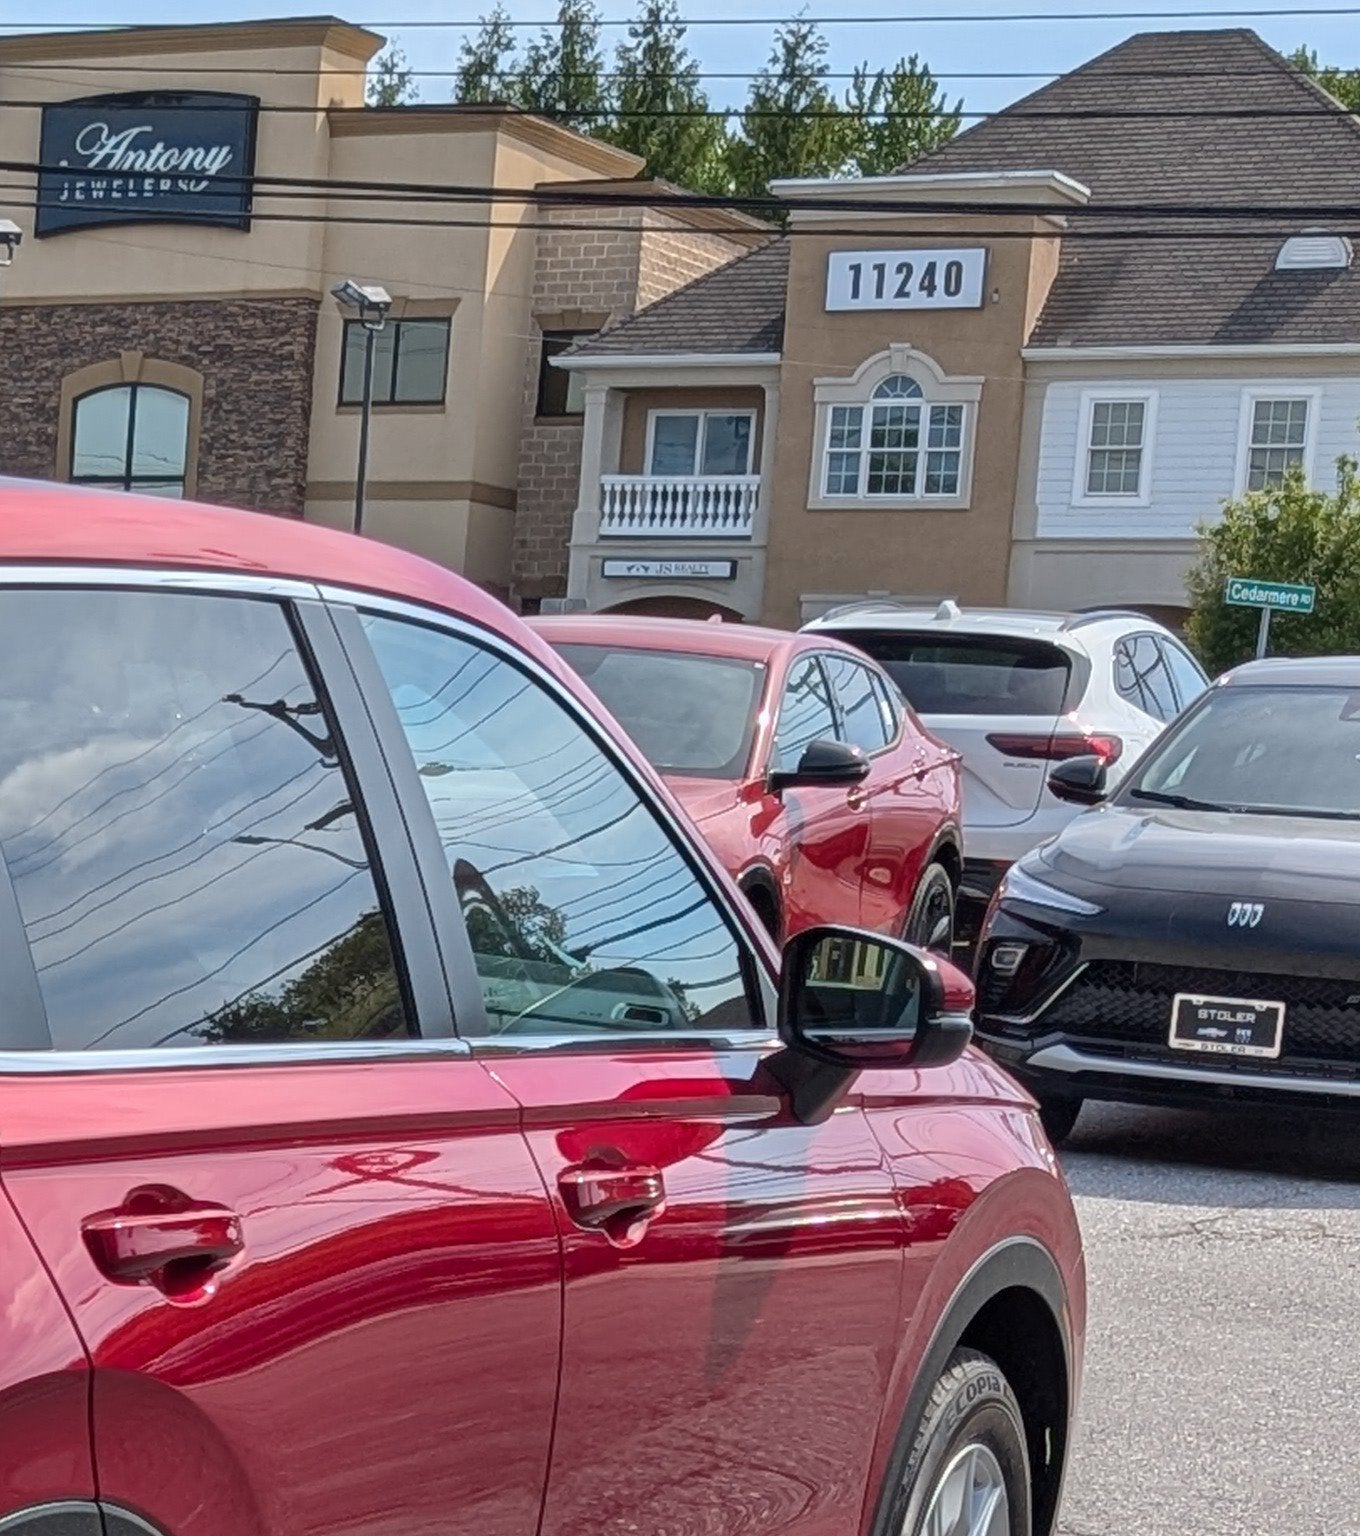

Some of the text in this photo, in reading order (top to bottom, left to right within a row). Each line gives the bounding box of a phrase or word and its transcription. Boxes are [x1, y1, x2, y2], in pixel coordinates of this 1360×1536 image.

[59, 122, 233, 192] Antony
[848, 259, 963, 300] 11240
[1231, 583, 1299, 606] Cedarmere
[1197, 1008, 1257, 1024] STOLER
